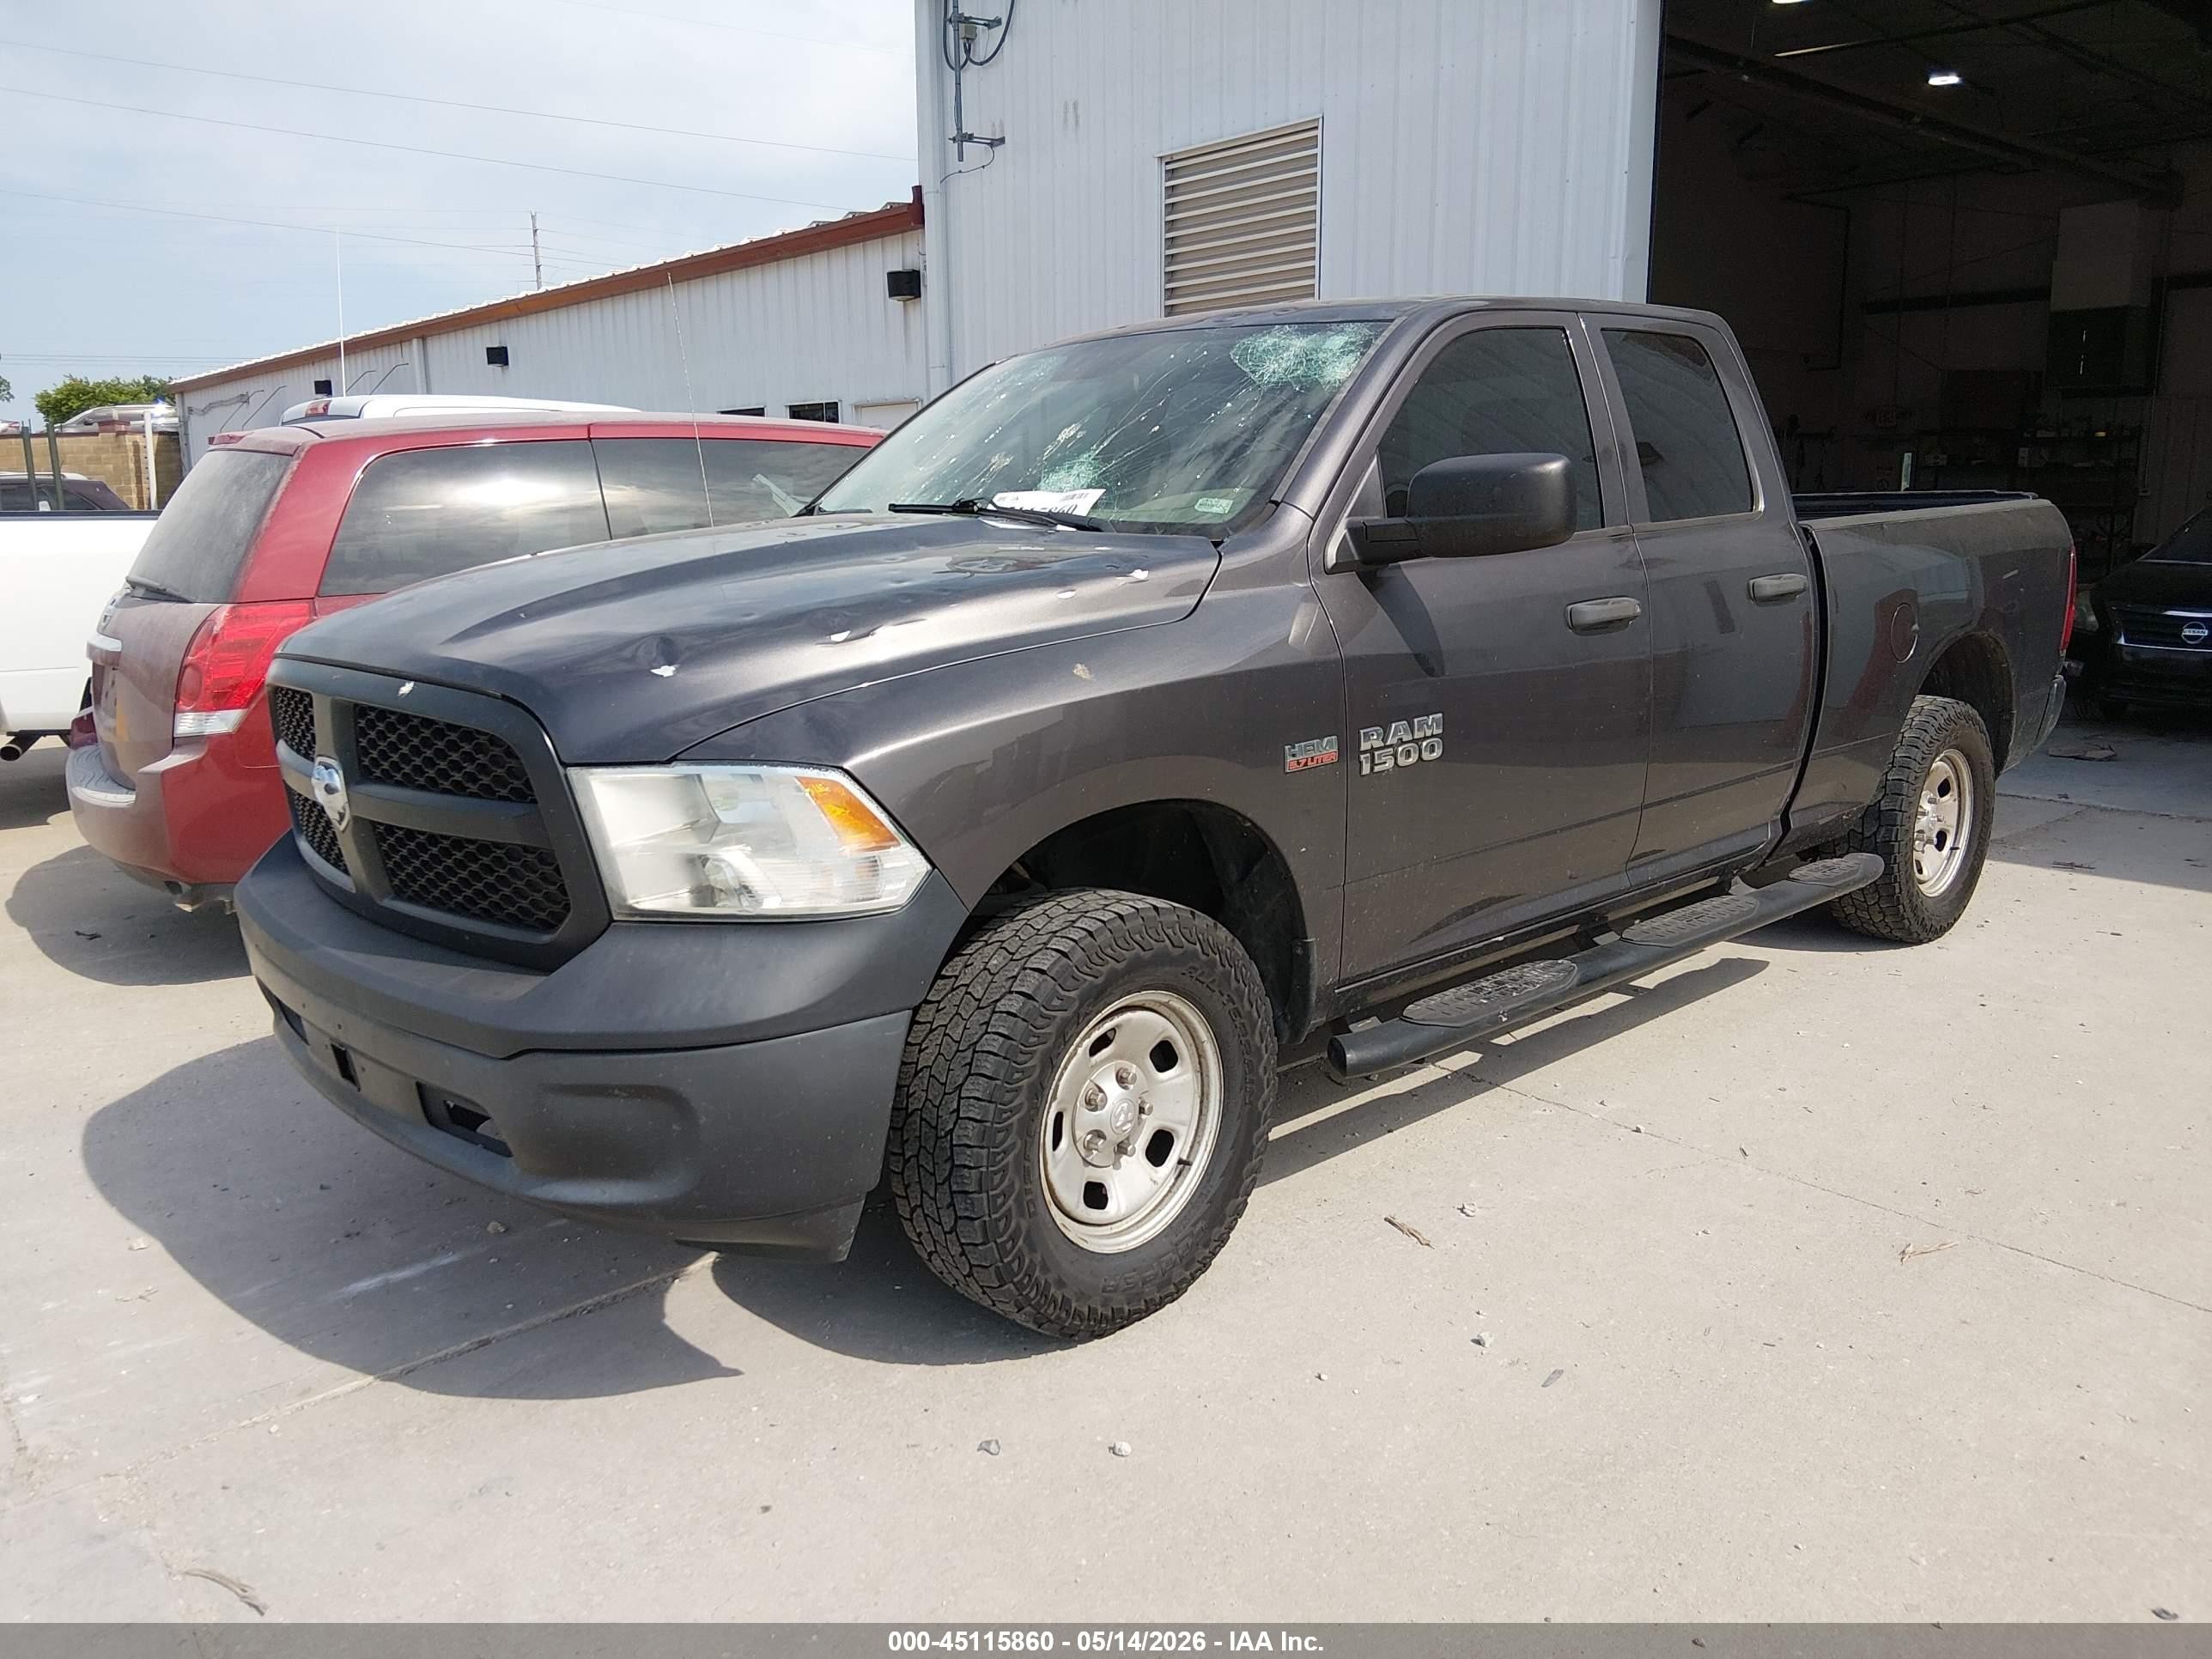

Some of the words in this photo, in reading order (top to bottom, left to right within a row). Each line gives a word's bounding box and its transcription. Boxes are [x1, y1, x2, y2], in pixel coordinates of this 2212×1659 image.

[1359, 713, 1443, 751] RAM
[1285, 736, 1338, 759] HEMI
[1289, 757, 1307, 770] 5.7
[1308, 751, 1337, 766] LITER
[1359, 738, 1443, 776] 1500
